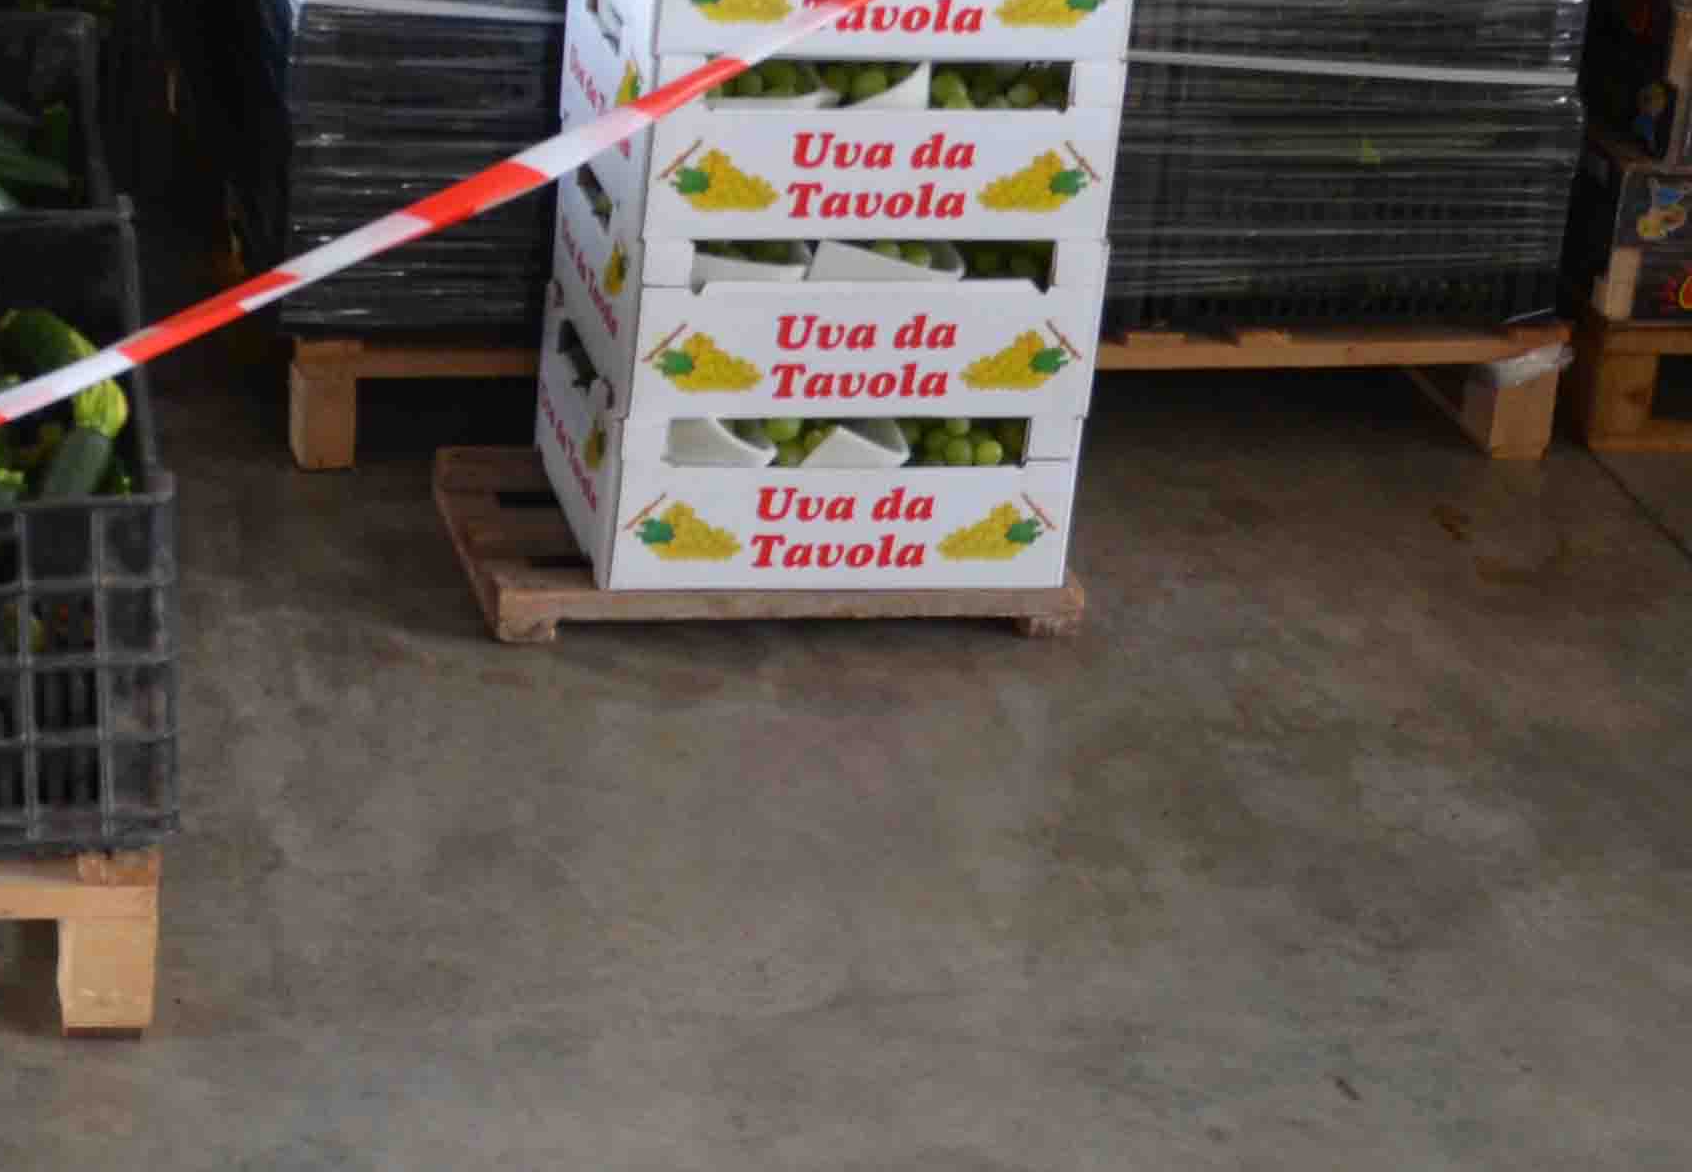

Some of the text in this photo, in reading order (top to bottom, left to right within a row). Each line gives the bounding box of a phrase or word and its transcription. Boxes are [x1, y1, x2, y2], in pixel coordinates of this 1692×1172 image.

[792, 130, 976, 171] Uva da
[786, 182, 966, 221] Tavola
[776, 314, 957, 351] Uva da
[770, 362, 950, 399] Tavola
[757, 485, 935, 523] Uva da
[750, 533, 926, 569] Tavola
